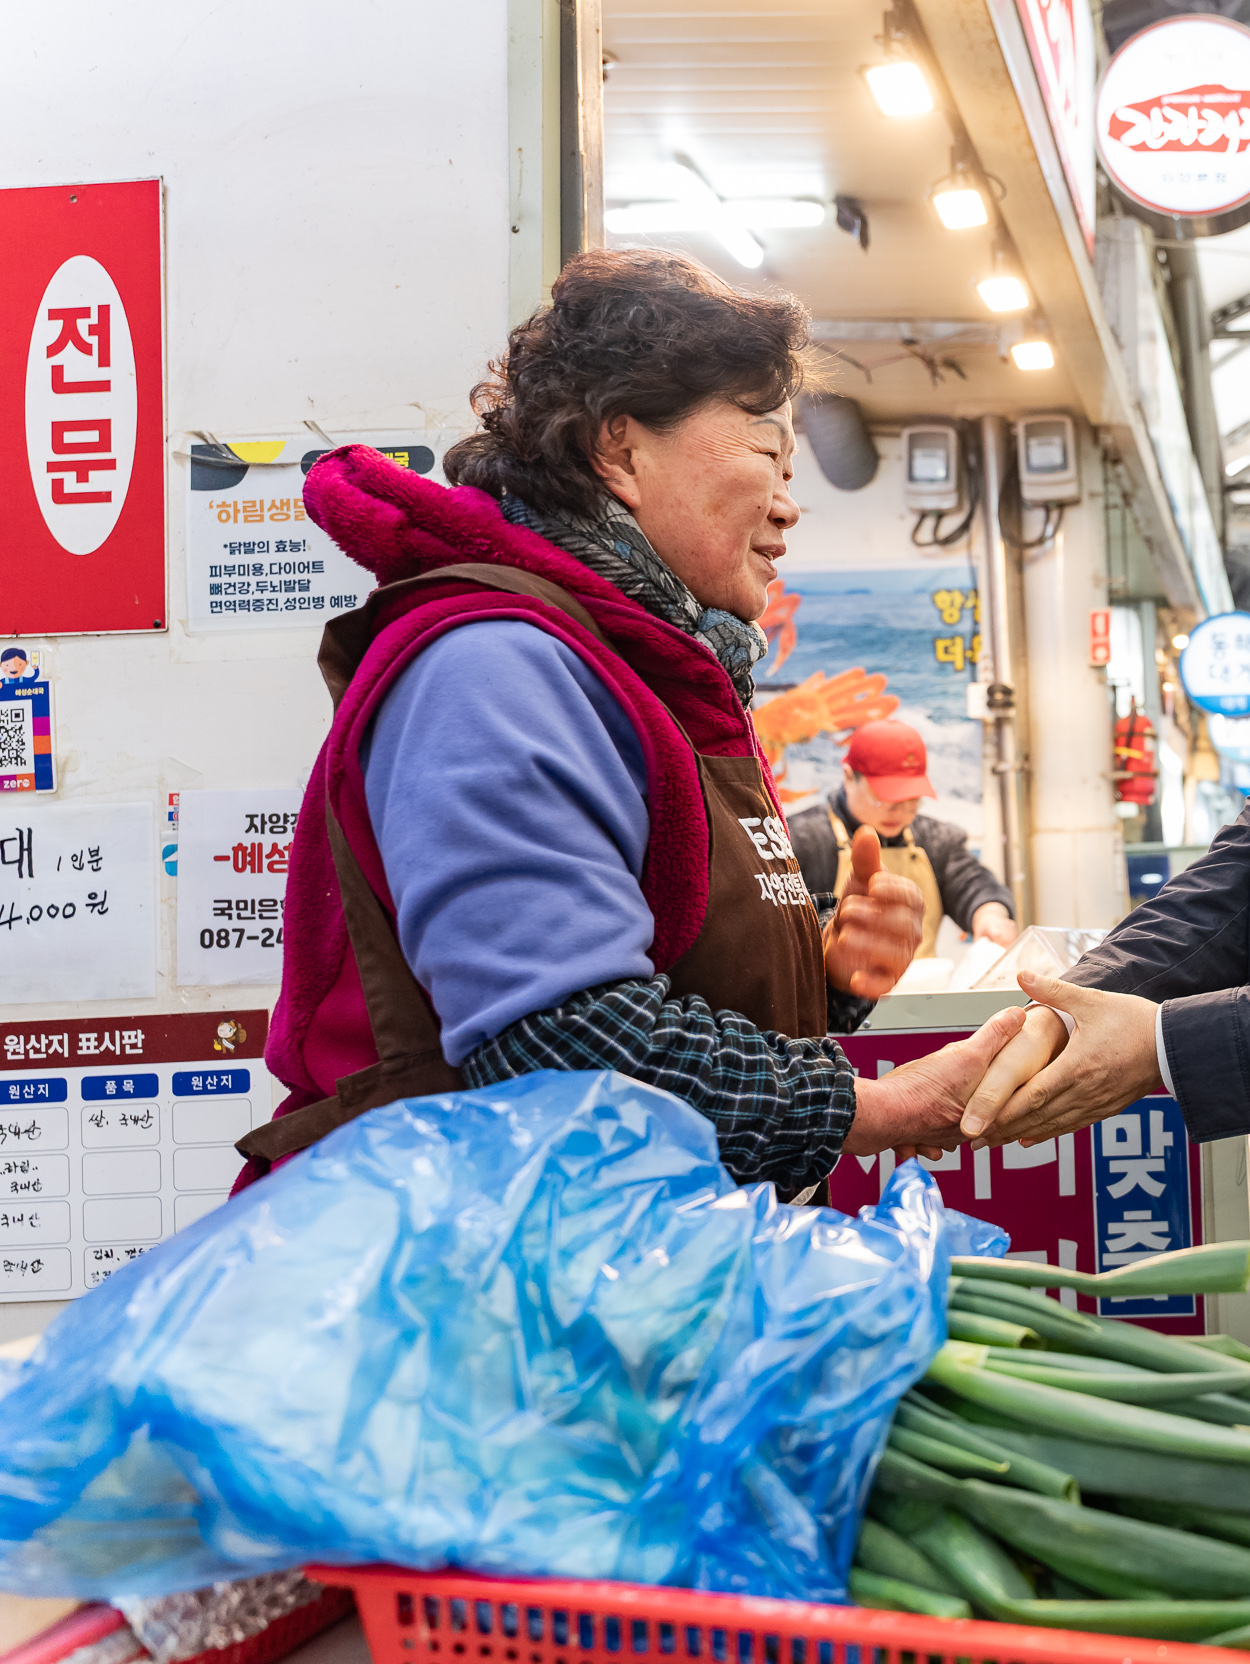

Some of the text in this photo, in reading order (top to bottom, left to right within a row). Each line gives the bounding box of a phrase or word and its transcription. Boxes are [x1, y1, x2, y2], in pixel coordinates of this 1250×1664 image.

[46, 304, 117, 504] 전문
[274, 539, 307, 554] 효능!
[208, 560, 325, 579] 피부미용,다이어트
[208, 579, 312, 597] 뼈건강,두뇌발달
[209, 594, 358, 614] 면역력증진,성인병 예방
[0, 827, 34, 879] 대
[70, 845, 104, 872] 인분
[213, 898, 286, 921] 국민은
[4, 1028, 146, 1061] 원산지 표시판
[8, 1083, 50, 1100] 원산지
[105, 1079, 135, 1095] 품목
[191, 1074, 233, 1090] 원산지
